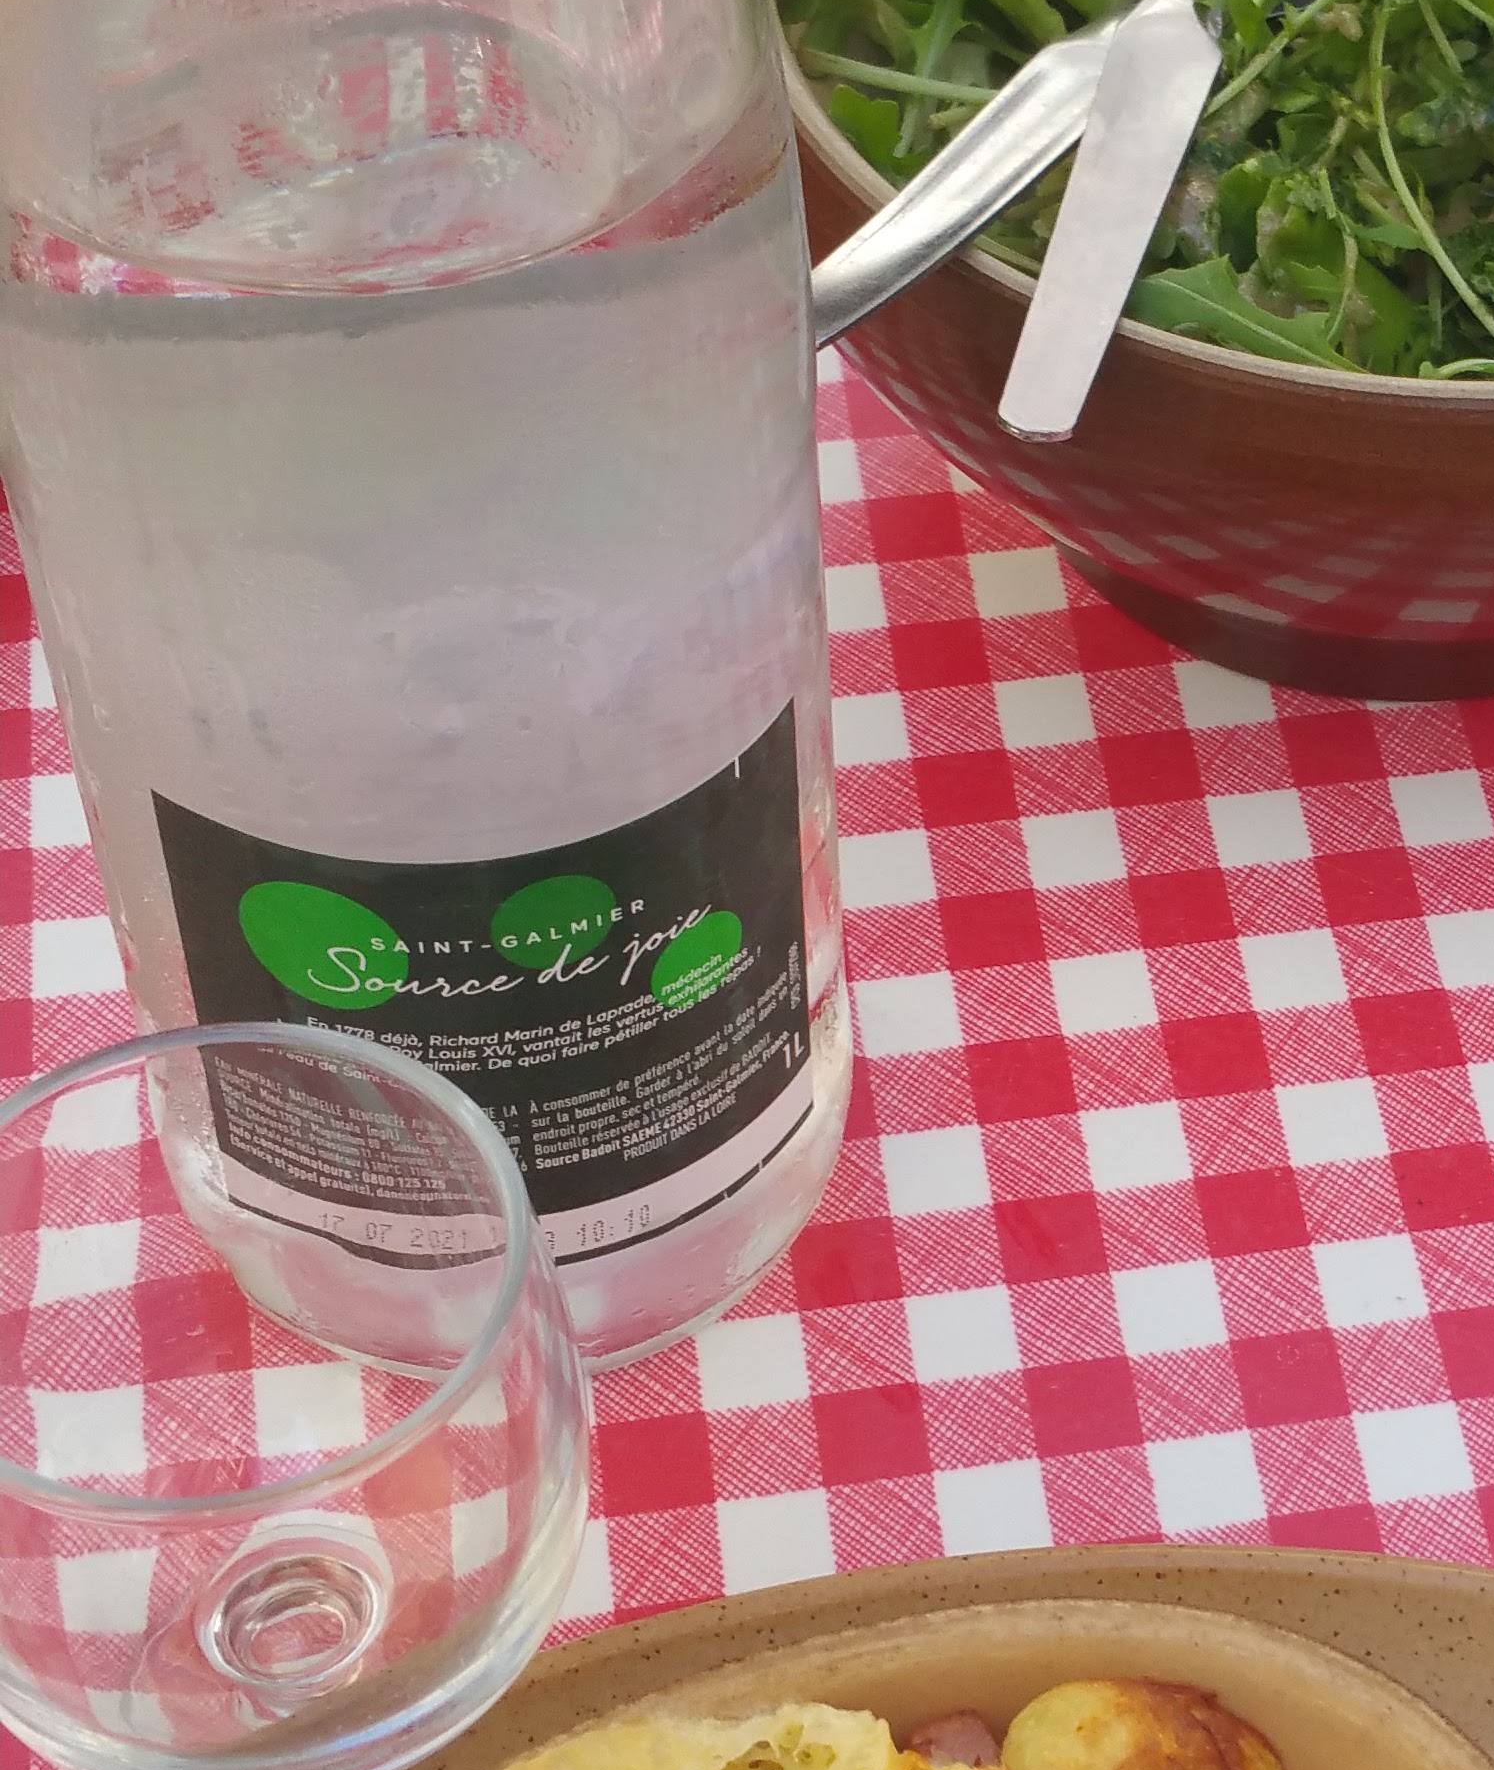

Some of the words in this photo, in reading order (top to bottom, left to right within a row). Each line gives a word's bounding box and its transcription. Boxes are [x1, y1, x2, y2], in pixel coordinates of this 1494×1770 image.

[306, 946, 525, 998] Source
[537, 943, 610, 985] de
[620, 904, 713, 987] joie
[370, 898, 646, 954] SAINT-GALMIER
[380, 1032, 423, 1048] déjà,
[429, 1032, 499, 1047] Richard
[504, 1025, 554, 1043] Marin
[558, 1019, 582, 1033] de
[586, 993, 657, 1026] Laprade,
[661, 953, 723, 996] médecin
[428, 1047, 478, 1059] Louis
[522, 1031, 583, 1053] vantait
[587, 1024, 611, 1039] les
[616, 1002, 665, 1029] vertus
[667, 947, 748, 1005] exhilarantes
[488, 1058, 513, 1070] De
[517, 1049, 557, 1068] quoi
[561, 1041, 601, 1058] faire
[604, 1016, 660, 1049] pétiller
[662, 998, 695, 1022] tous
[697, 983, 718, 1003] les
[720, 955, 755, 988] repas
[530, 1115, 551, 1128] sur
[556, 1111, 570, 1123] la
[635, 1075, 671, 1099] Garder
[542, 1086, 612, 1112] consommer
[616, 1079, 630, 1093] de
[634, 1051, 691, 1088] préférence
[502, 1105, 518, 1118] LA
[532, 1124, 577, 1142] endroit
[621, 1104, 642, 1119] sec
[643, 1097, 655, 1111] et
[534, 1135, 590, 1156] Bouteille
[591, 1118, 641, 1144] réservée
[623, 1132, 668, 1162] PRODUIT
[669, 1118, 697, 1142] DANS
[698, 1109, 711, 1127] LA
[535, 1152, 580, 1170] Source
[581, 1139, 622, 1161] Badoit
[622, 1121, 662, 1147] SAEME
[397, 1177, 421, 1188] 125
